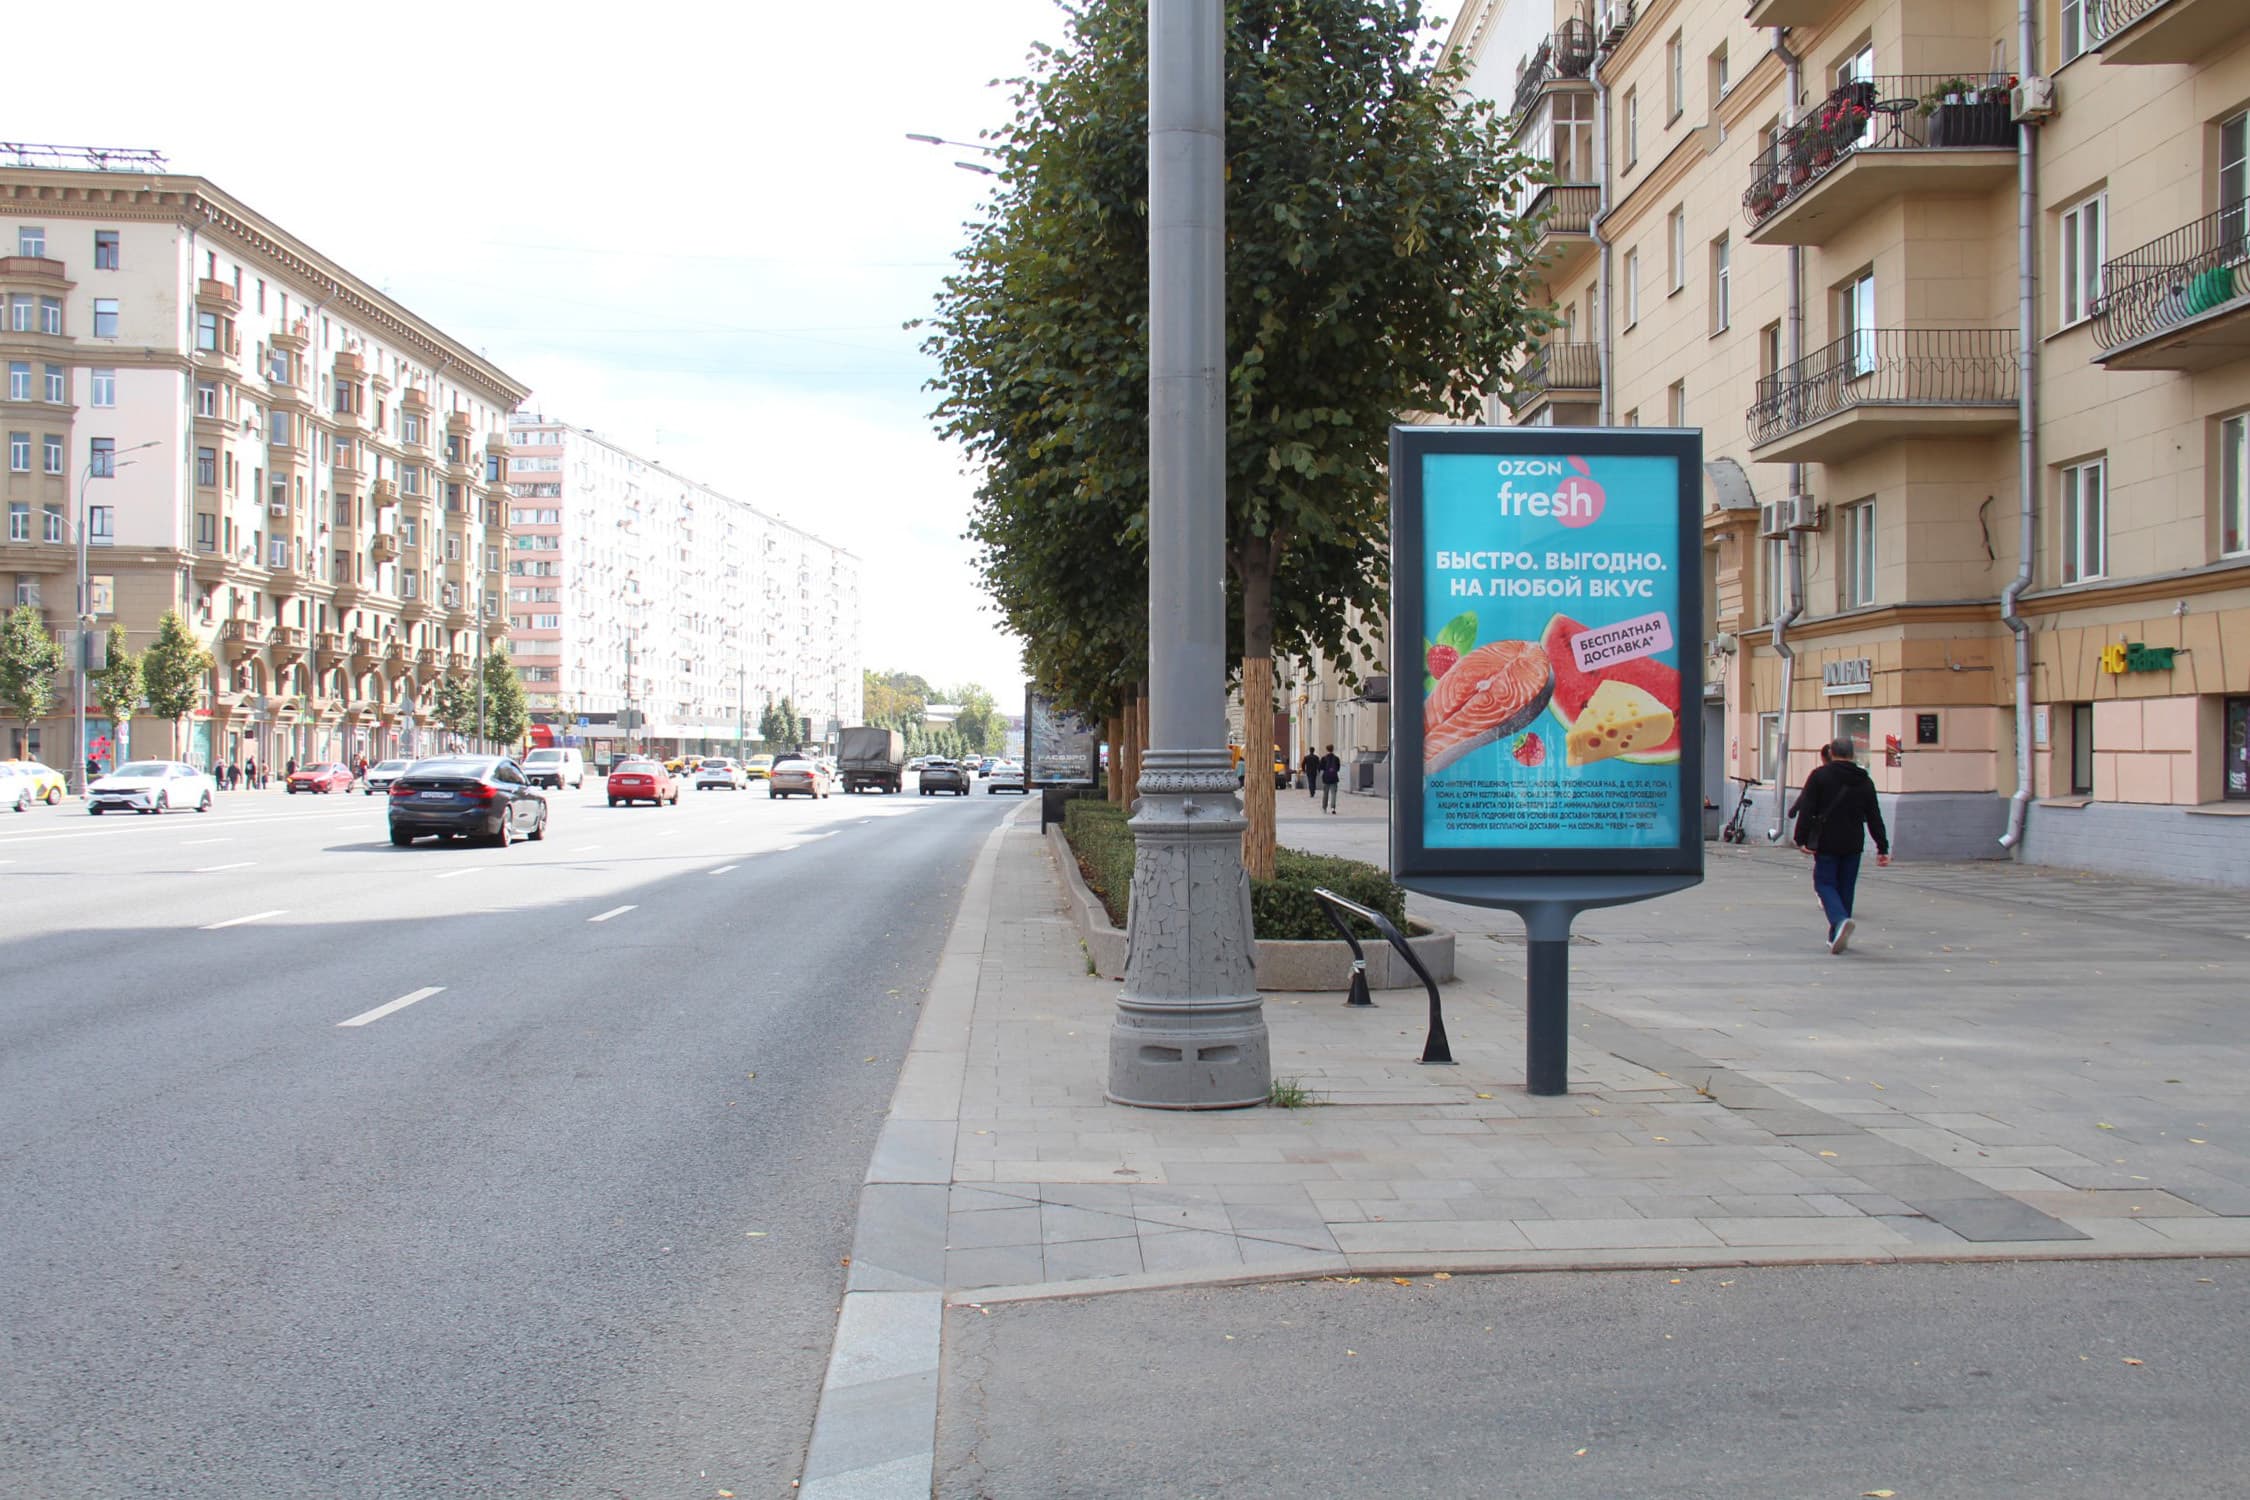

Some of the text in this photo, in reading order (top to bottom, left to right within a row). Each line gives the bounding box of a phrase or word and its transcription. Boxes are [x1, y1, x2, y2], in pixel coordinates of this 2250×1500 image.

[1498, 460, 1562, 476] OZON
[1497, 481, 1592, 517] fresh
[1436, 551, 1668, 574] БЫСТРО. ВЫГОДНО.
[1450, 575, 1653, 598] НА ЛЮБОЙ ВКУС
[1580, 619, 1661, 651] БЕСПЛАТНАЯ
